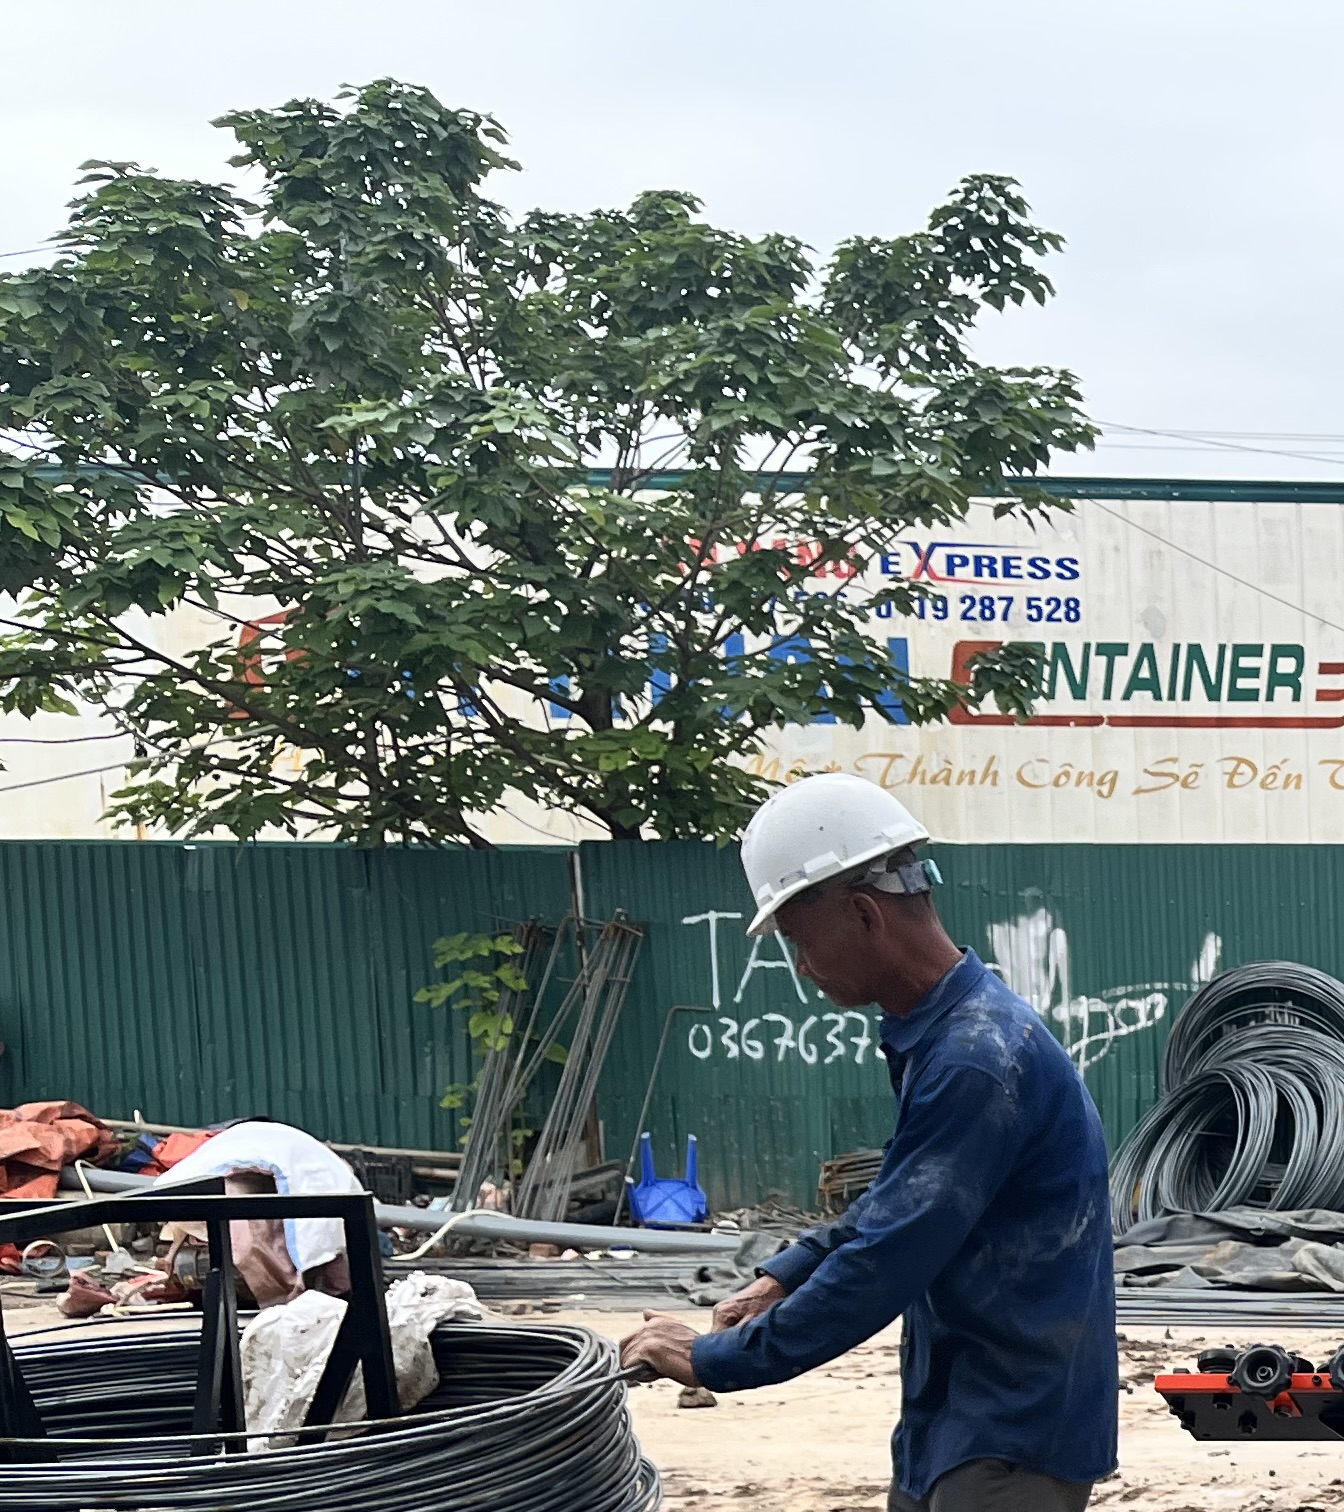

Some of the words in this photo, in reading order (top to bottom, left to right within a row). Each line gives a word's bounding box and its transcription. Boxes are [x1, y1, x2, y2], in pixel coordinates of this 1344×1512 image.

[880, 542, 1080, 581] EXPRESS
[876, 594, 949, 621] 019
[959, 594, 1014, 621] 287
[1025, 596, 1081, 623] 528
[854, 752, 999, 790] Thành
[1015, 758, 1119, 800] Công
[1131, 756, 1204, 796] Sẽ
[1216, 755, 1302, 791] Đến
